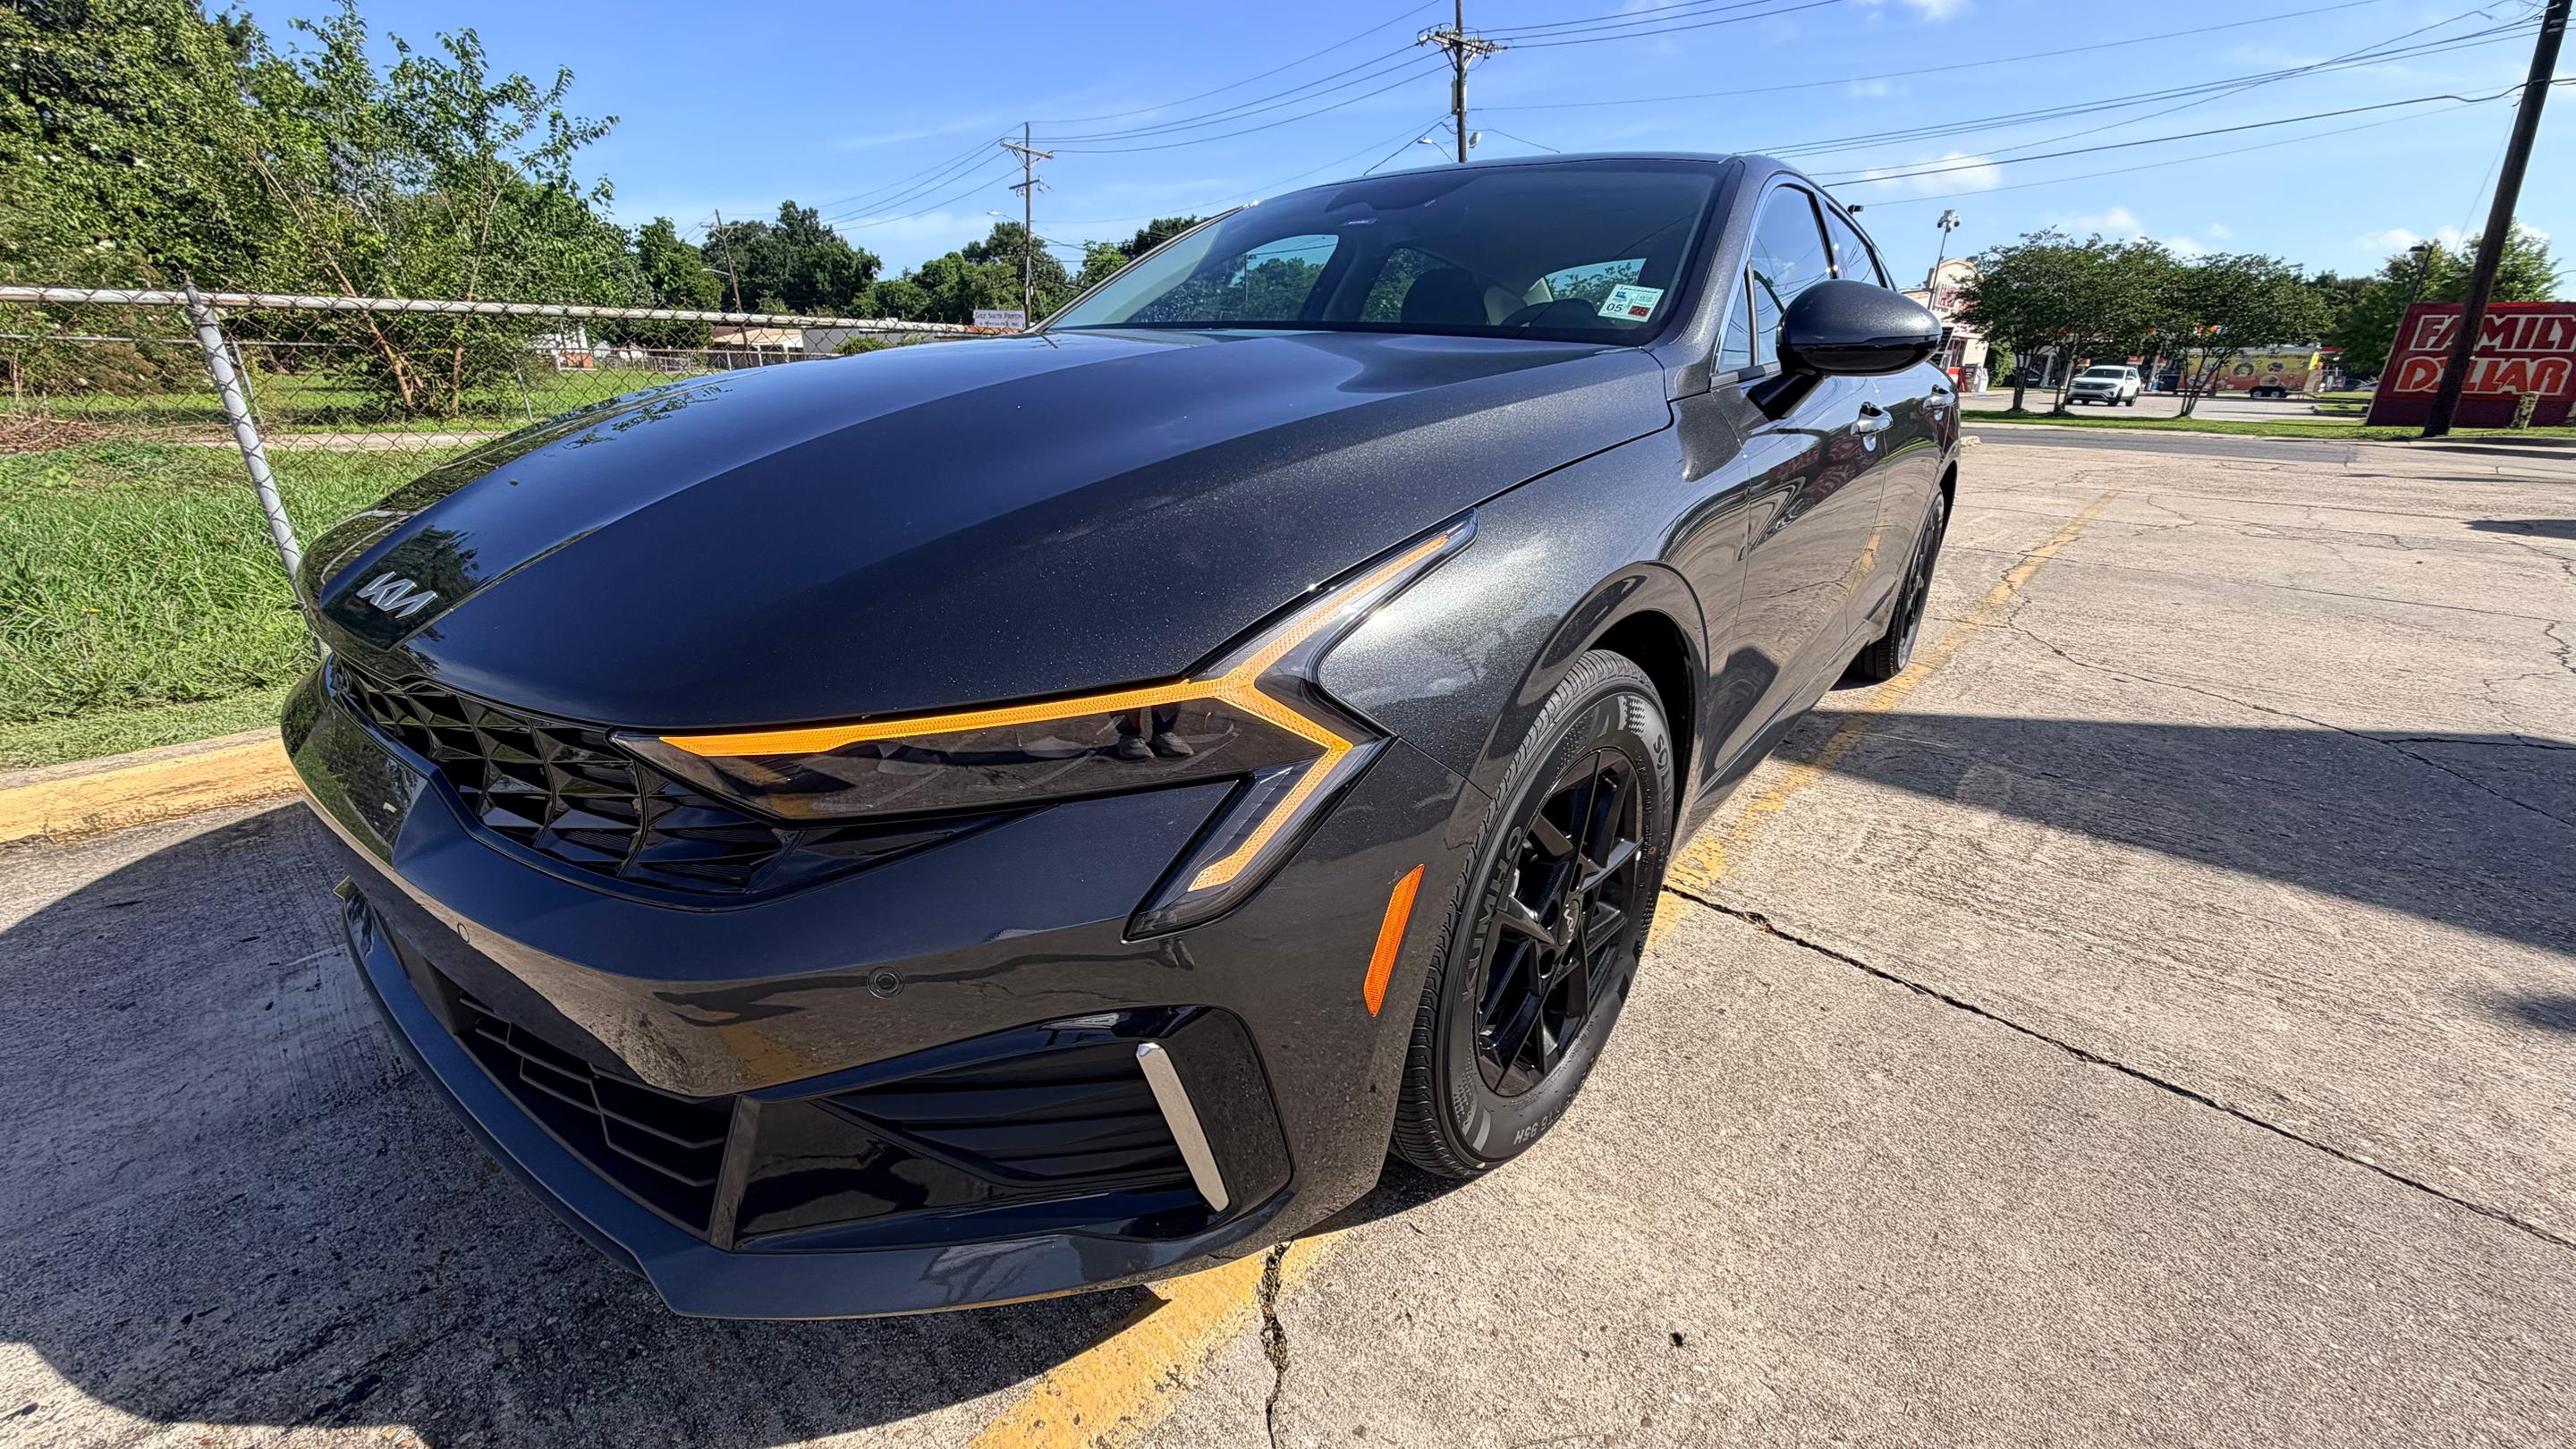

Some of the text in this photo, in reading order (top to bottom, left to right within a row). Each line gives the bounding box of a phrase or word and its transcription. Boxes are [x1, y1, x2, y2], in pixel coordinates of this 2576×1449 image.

[1606, 302, 1623, 313] 05
[2394, 356, 2572, 396] DLLAR
[356, 572, 438, 619] KIA
[1462, 826, 1522, 1003] KUMHO
[1513, 1122, 1539, 1145] 95H
